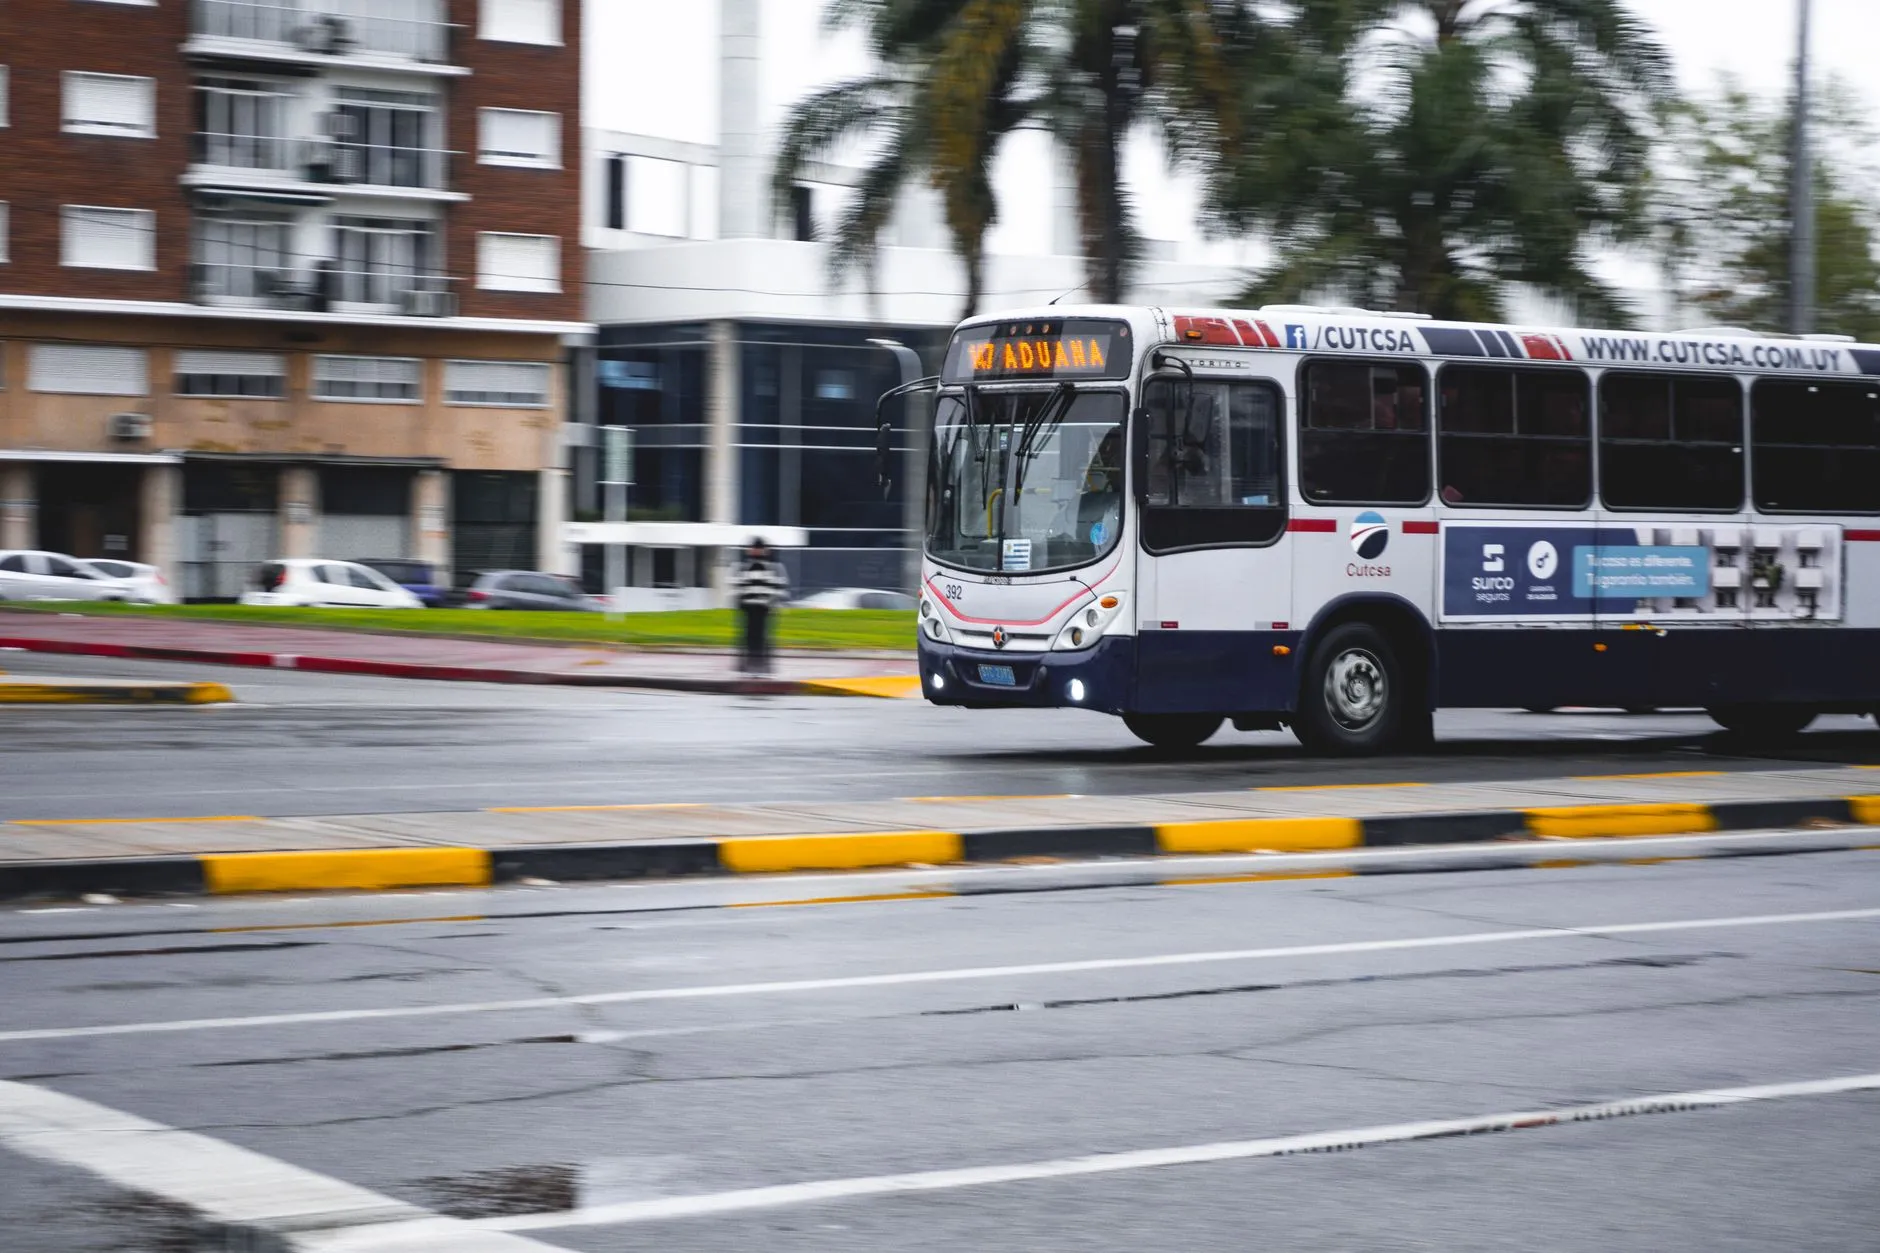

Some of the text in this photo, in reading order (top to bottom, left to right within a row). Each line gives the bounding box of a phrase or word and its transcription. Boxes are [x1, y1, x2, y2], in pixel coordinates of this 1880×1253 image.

[1004, 338, 1104, 369] ADUANA
[1580, 336, 1840, 371] WWW.CUTCSA.COM.UY
[1346, 562, 1391, 577] Cutcsa
[1471, 577, 1515, 590] surco
[945, 584, 963, 600] 392
[1476, 592, 1511, 603] seguros
